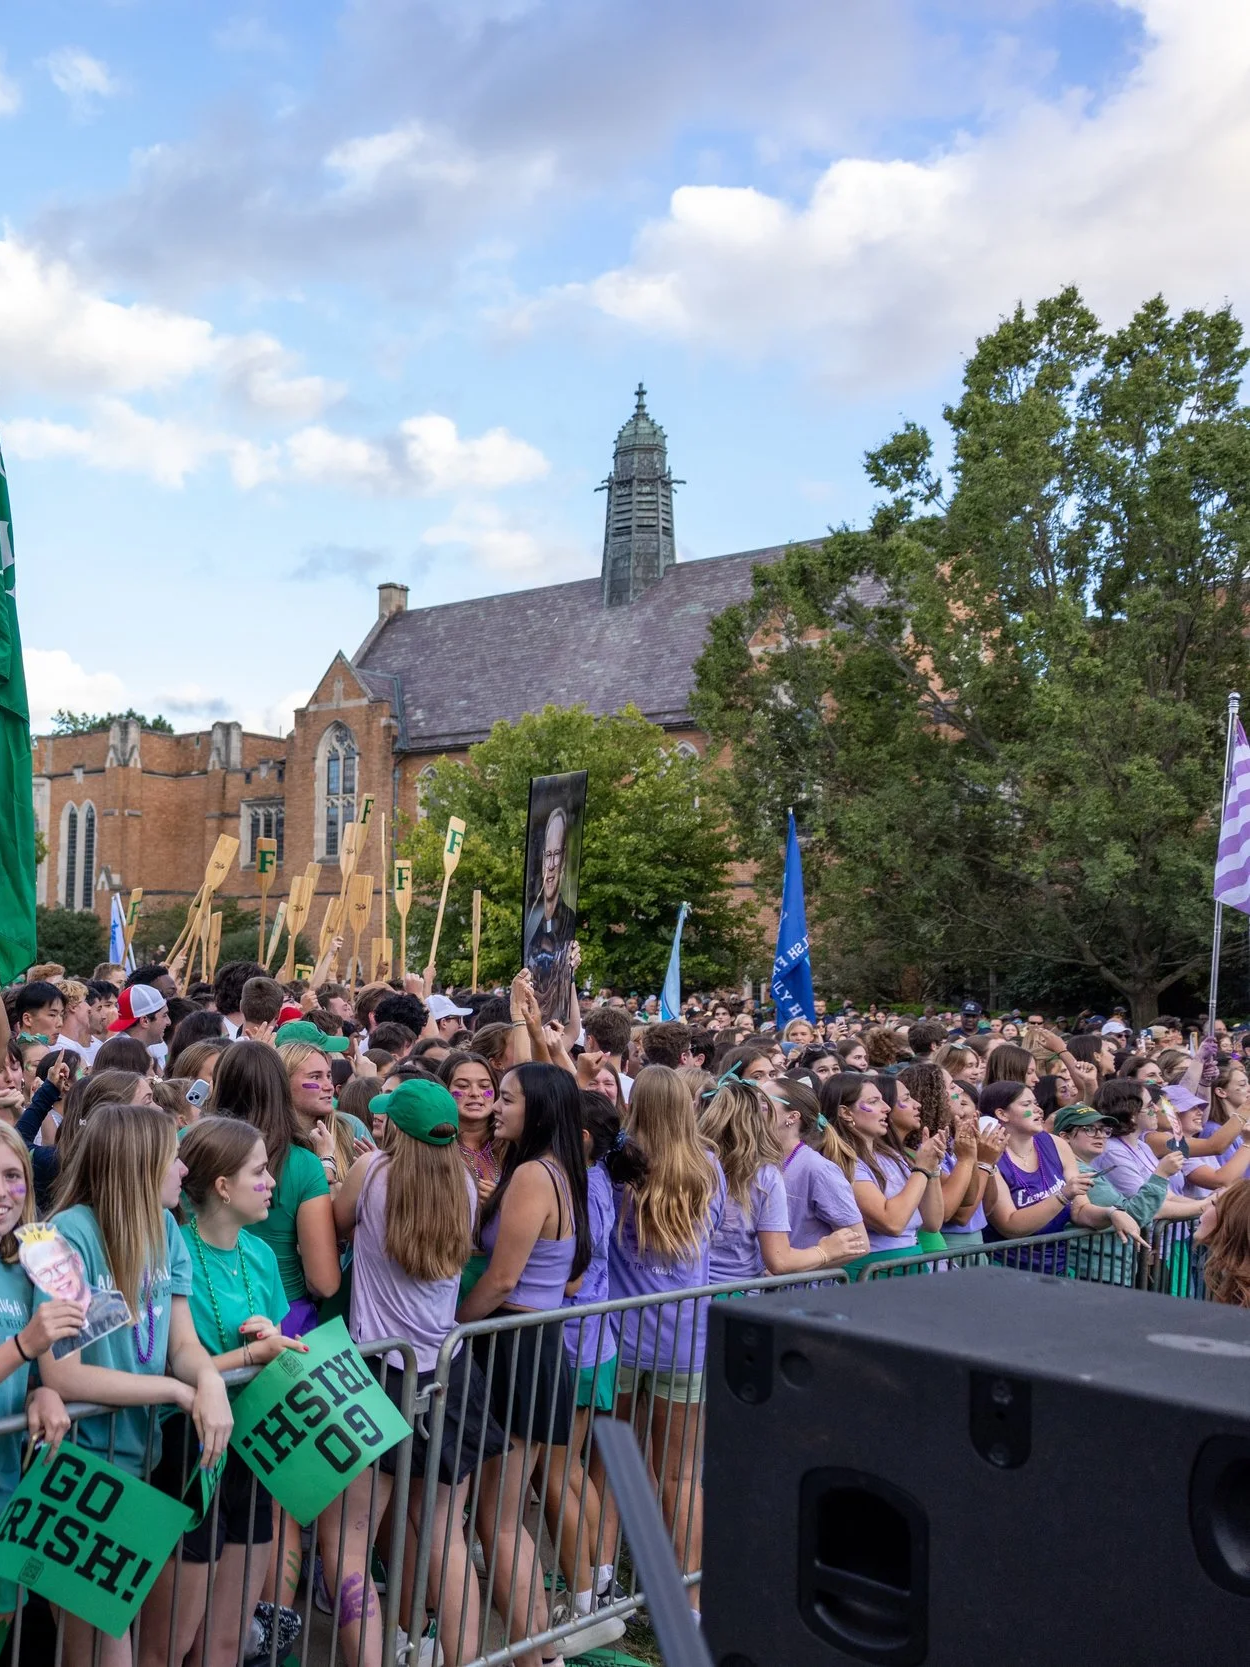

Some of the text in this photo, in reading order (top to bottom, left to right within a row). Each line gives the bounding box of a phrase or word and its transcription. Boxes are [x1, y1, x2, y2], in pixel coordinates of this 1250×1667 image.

[361, 799, 374, 823] F
[447, 829, 464, 854] F
[258, 850, 275, 873] F
[396, 867, 410, 890] F
[241, 1348, 373, 1476] IRISH!
[314, 1404, 384, 1475] GO
[40, 1453, 124, 1523] GO
